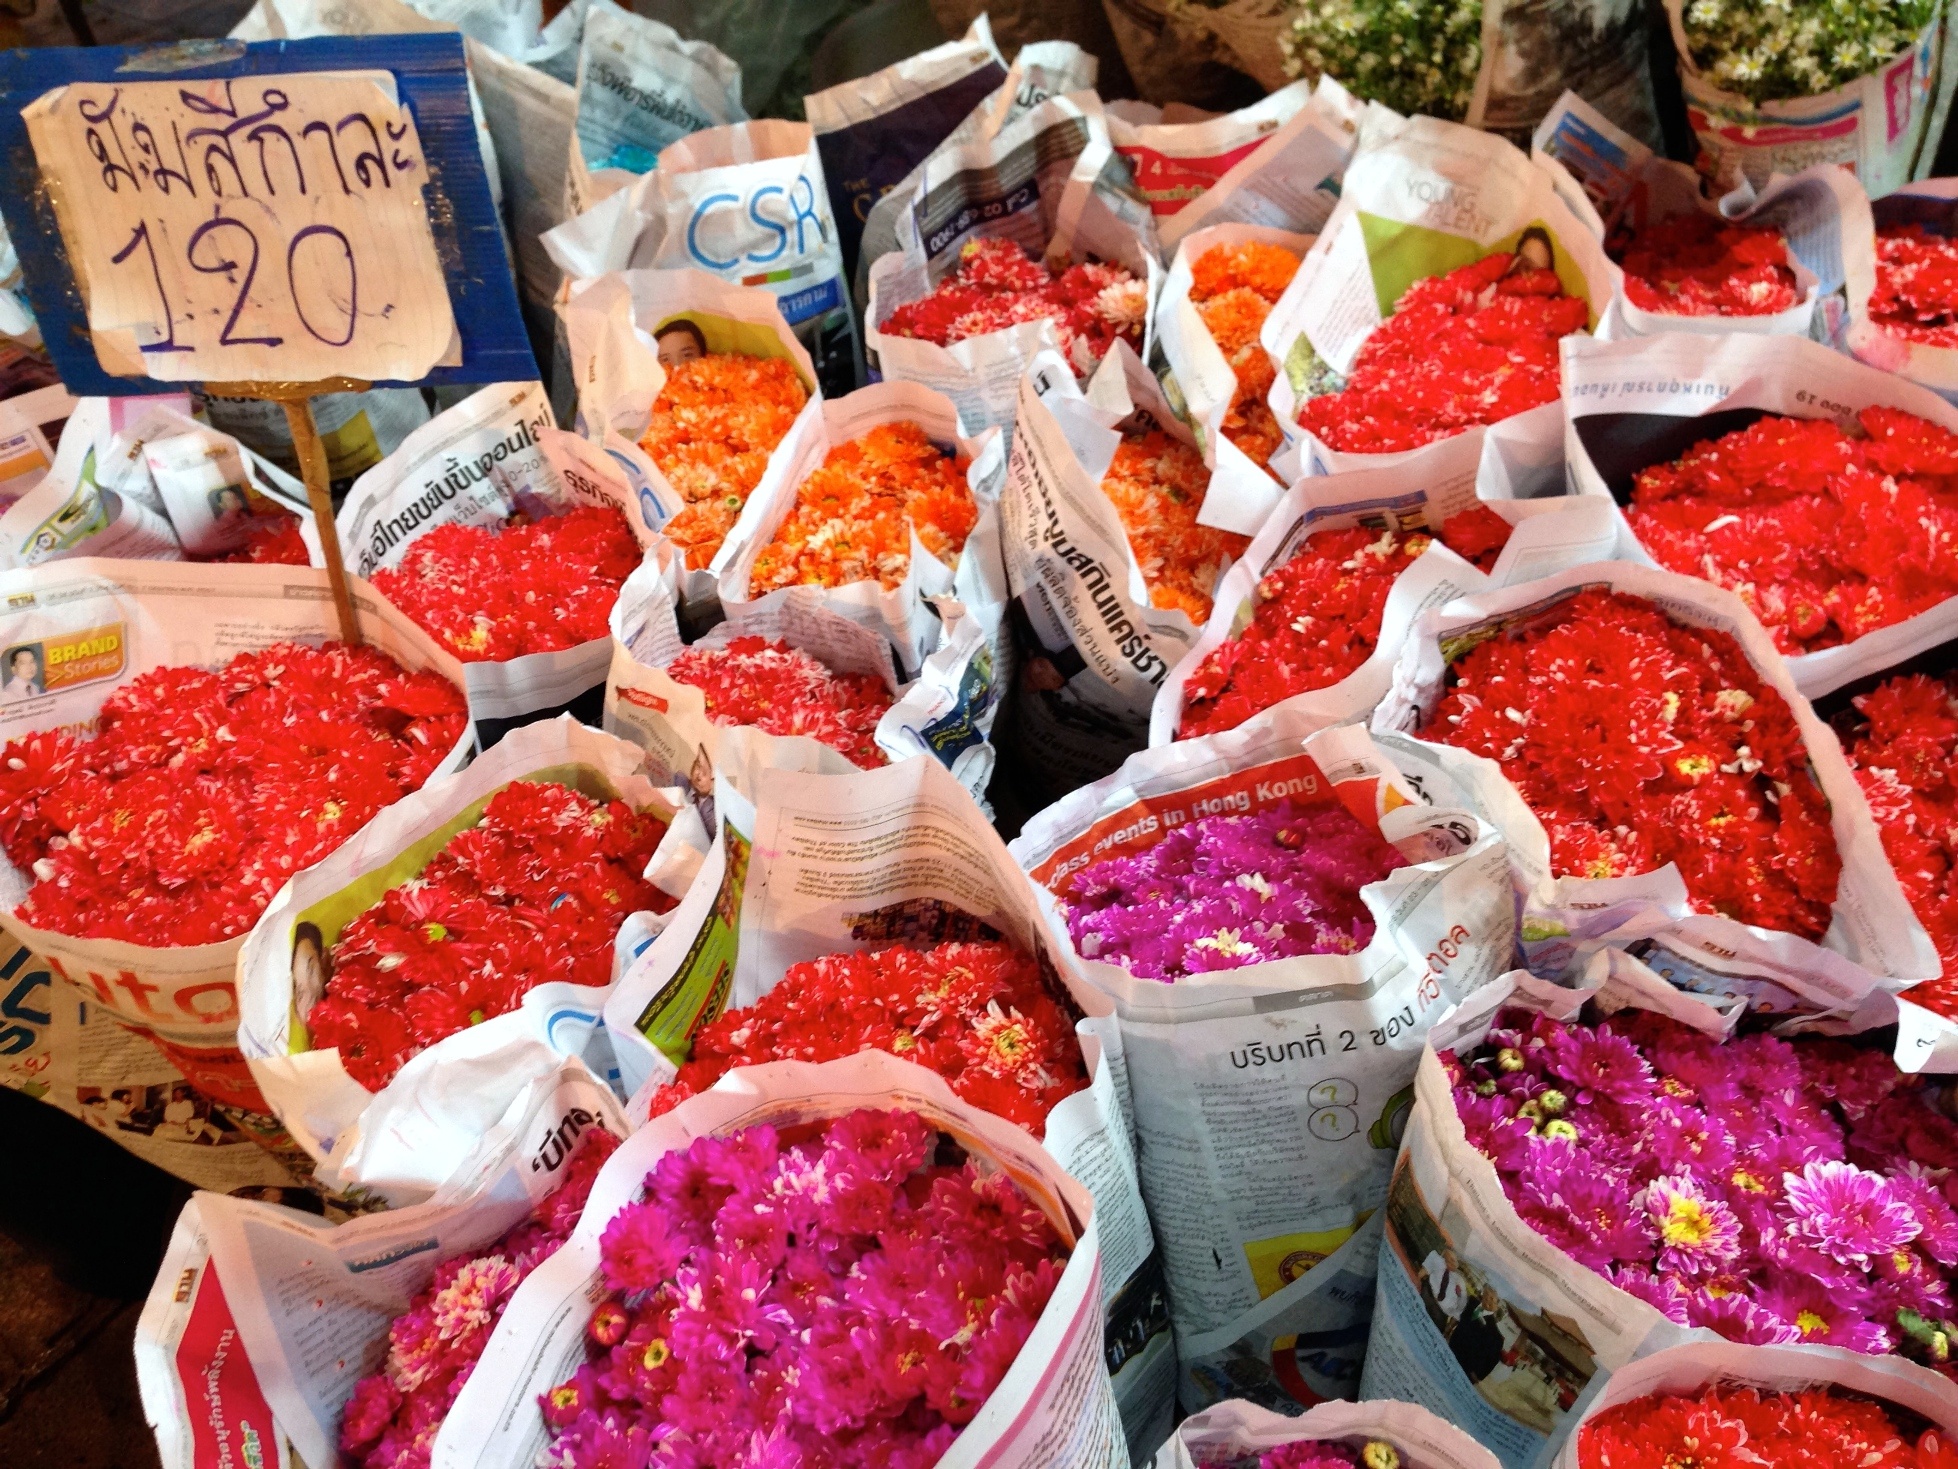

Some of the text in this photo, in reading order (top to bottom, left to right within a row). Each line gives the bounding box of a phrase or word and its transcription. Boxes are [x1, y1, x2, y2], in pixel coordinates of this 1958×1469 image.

[1405, 178, 1481, 212] YOUNG
[687, 175, 825, 270] CSR
[112, 212, 358, 353] 120
[47, 636, 119, 665] BRAND
[64, 655, 119, 681] Stories
[1093, 813, 1160, 853] events
[1161, 807, 1186, 828] in
[1192, 788, 1250, 820] Hong
[1255, 771, 1319, 802] Kong
[1230, 1025, 1326, 1070] บริบทที่
[1340, 1029, 1358, 1053] 2
[1369, 1006, 1416, 1047] ของ
[1560, 1278, 1607, 1319] Newspaper
